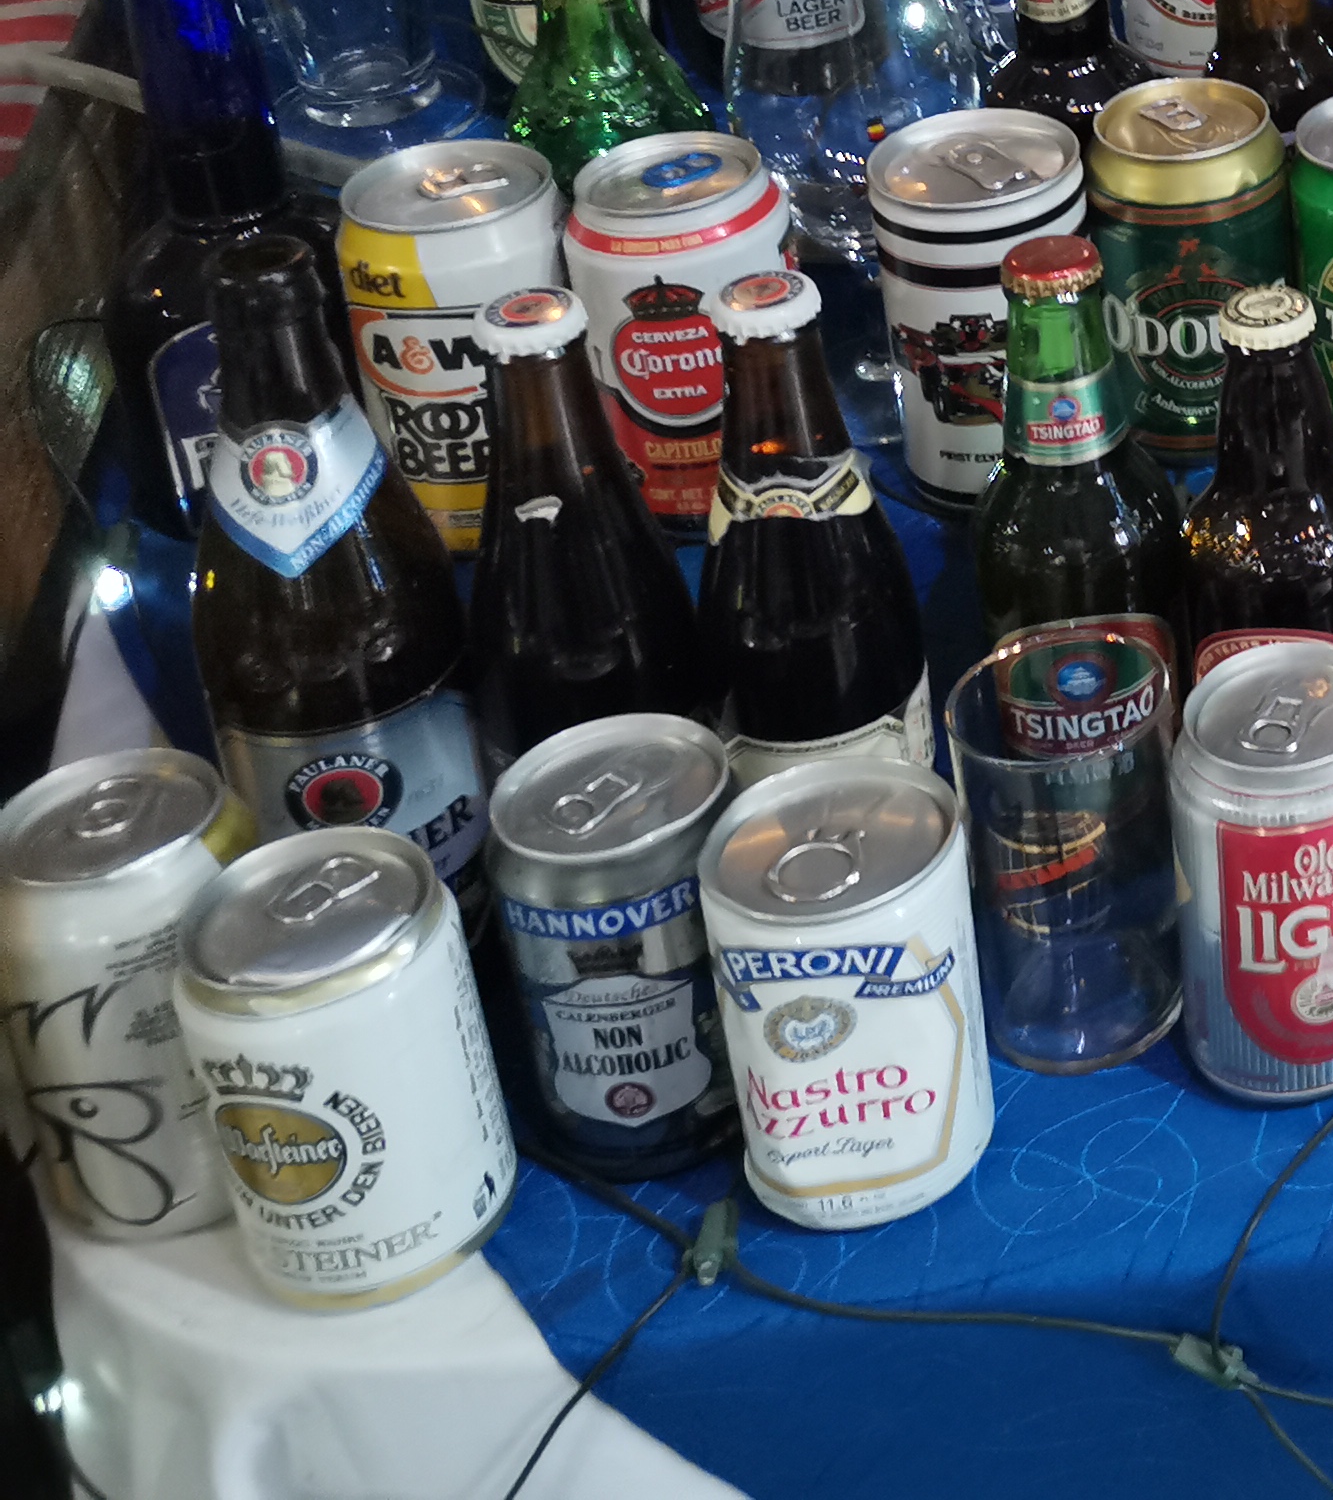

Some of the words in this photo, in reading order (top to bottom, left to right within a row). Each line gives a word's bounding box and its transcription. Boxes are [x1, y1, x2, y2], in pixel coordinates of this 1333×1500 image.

[785, 8, 843, 32] BEER
[349, 259, 406, 299] diet
[371, 334, 488, 374] A&W
[631, 326, 710, 344] CERVEZA
[653, 385, 708, 400] EXTRA
[1029, 422, 1100, 442] TSINGTAO
[1011, 683, 1157, 741] TSINGTAO
[291, 754, 390, 799] PAULANER
[508, 882, 695, 938] HANNOVER
[730, 947, 892, 985] PERONI
[862, 956, 954, 997] PREMIUM
[561, 1037, 691, 1077] ALCOHOLIC
[592, 1025, 643, 1050] NON
[747, 1063, 909, 1112] Nastro
[323, 1089, 387, 1156] BIEREN
[748, 1088, 937, 1140] Azzurro
[339, 1159, 385, 1207] DEN
[259, 1204, 346, 1230] UNTER
